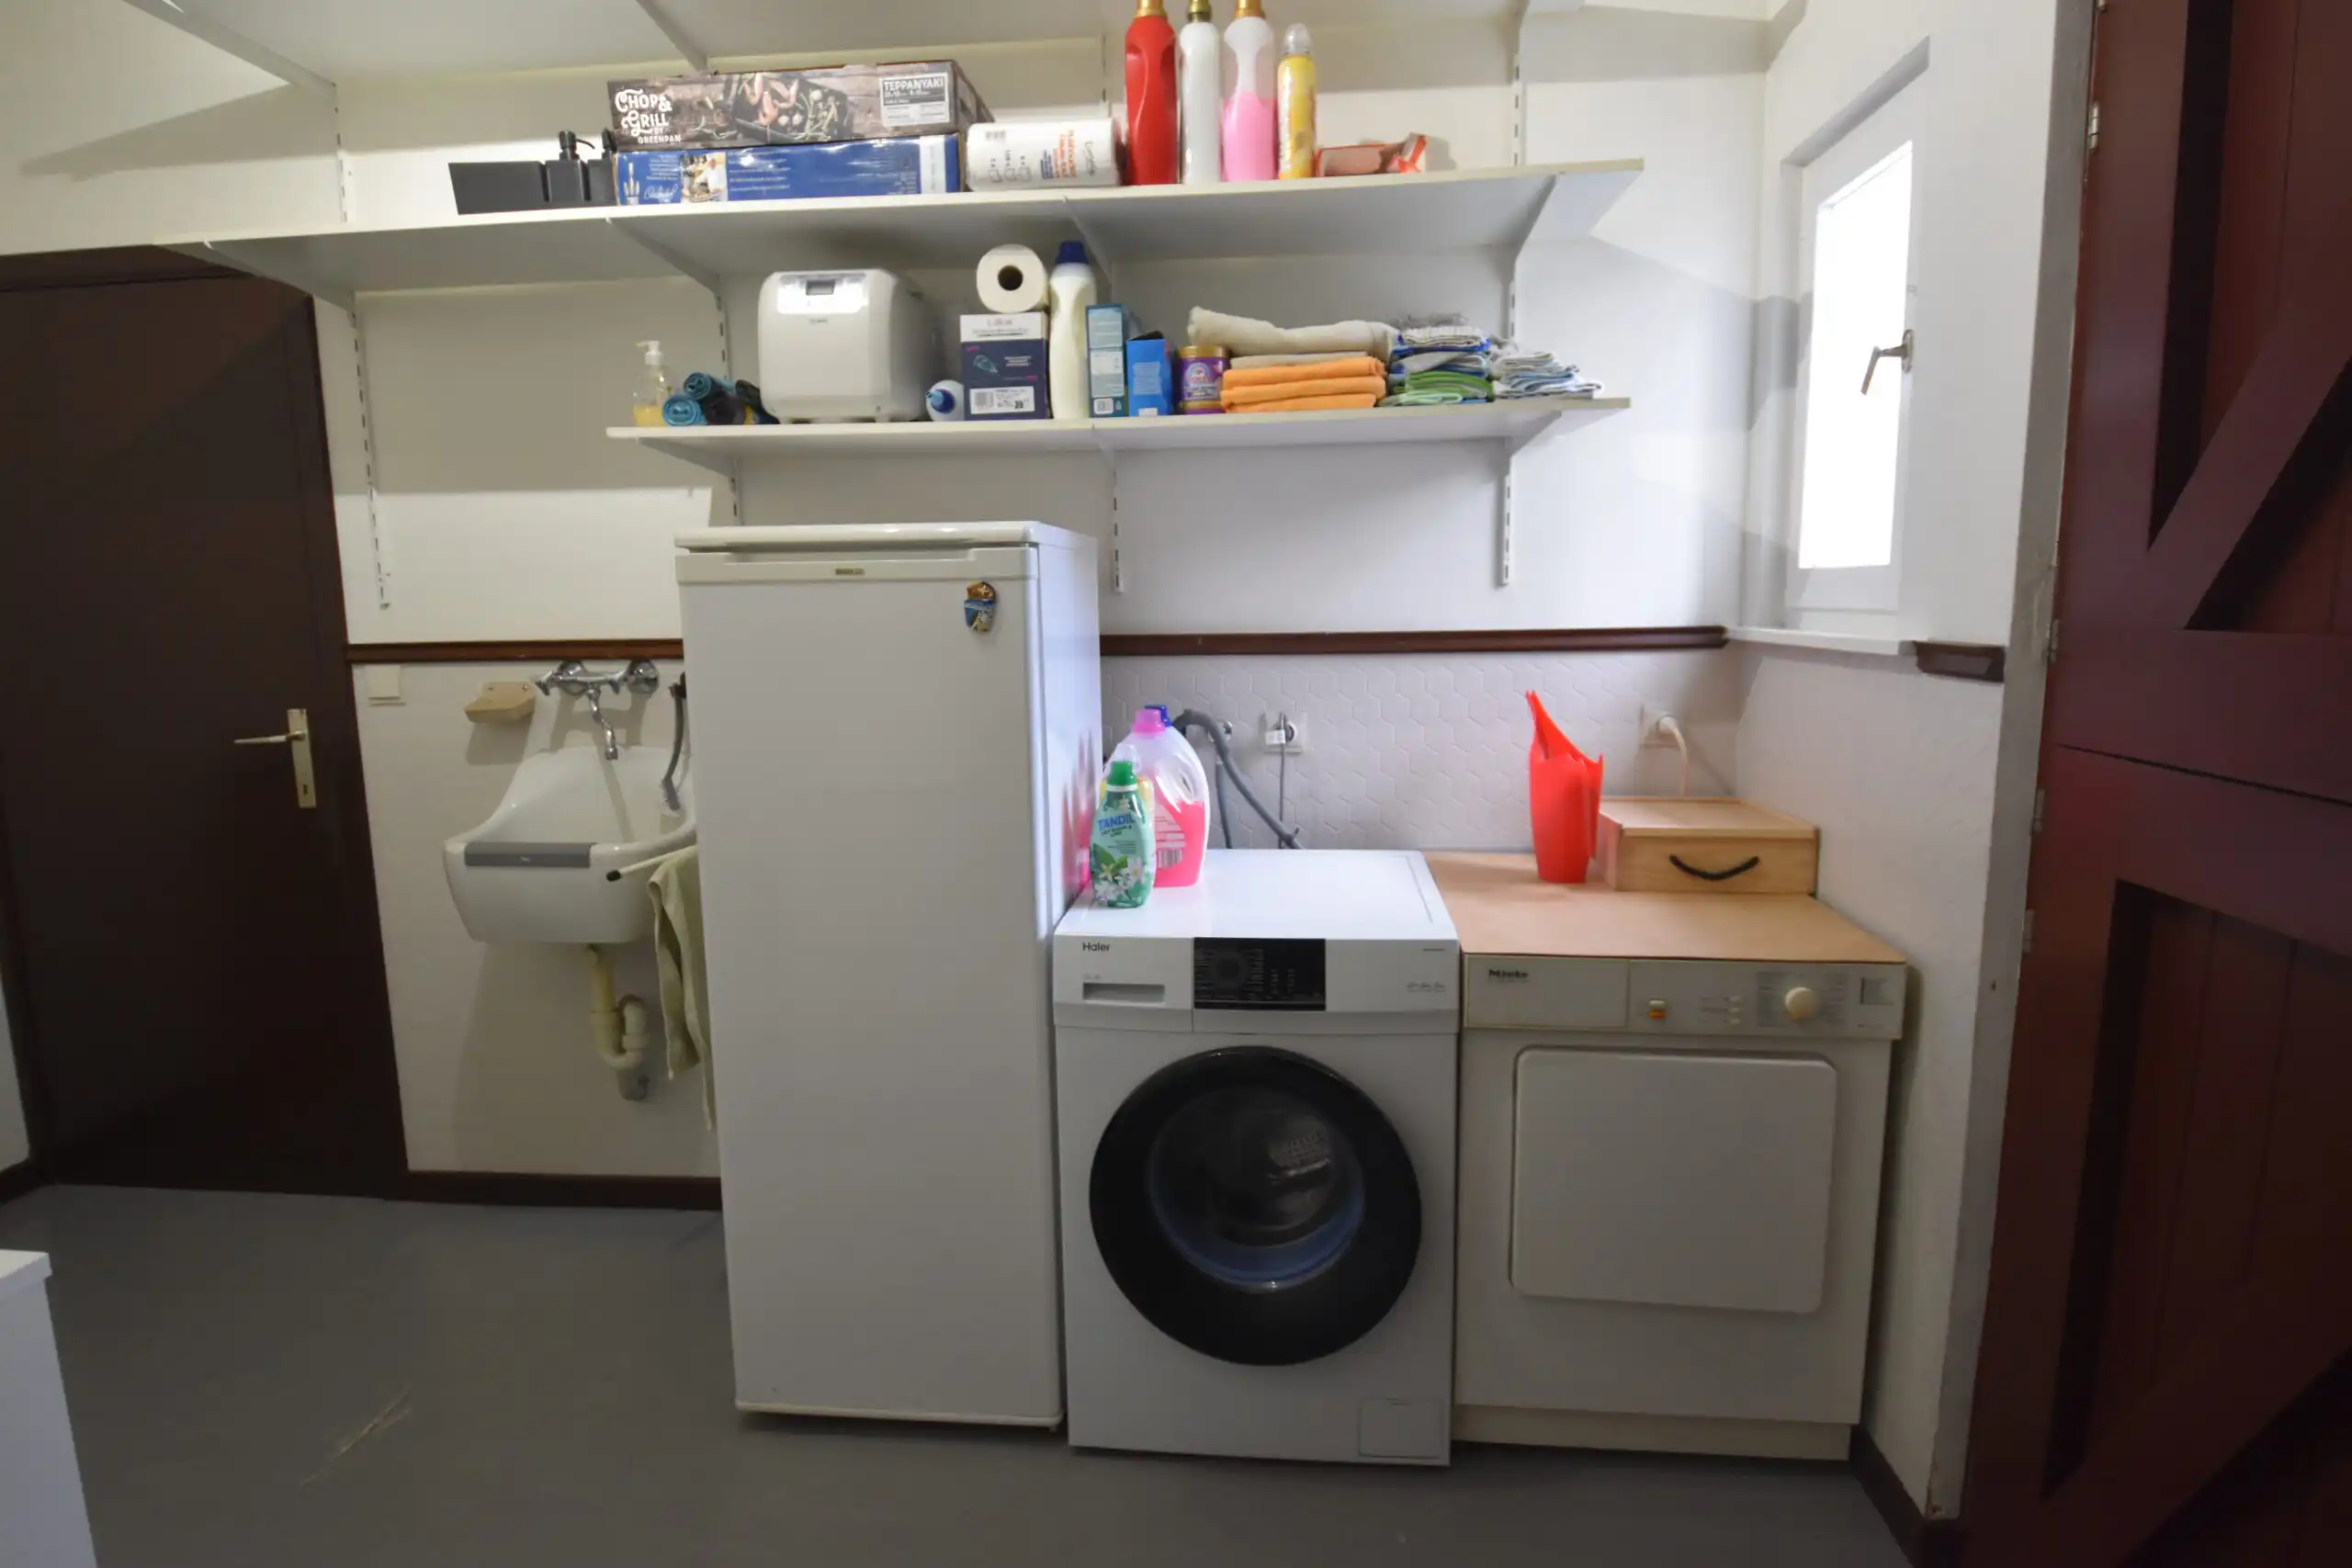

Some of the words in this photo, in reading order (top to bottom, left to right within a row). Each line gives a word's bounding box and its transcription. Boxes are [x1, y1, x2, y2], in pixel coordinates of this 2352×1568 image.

[884, 77, 944, 91] TEPPANYAKI
[620, 109, 669, 137] GRILL
[638, 134, 682, 144] GREENPAN
[1098, 814, 1135, 830] TANDIL
[1082, 942, 1110, 952] Haier
